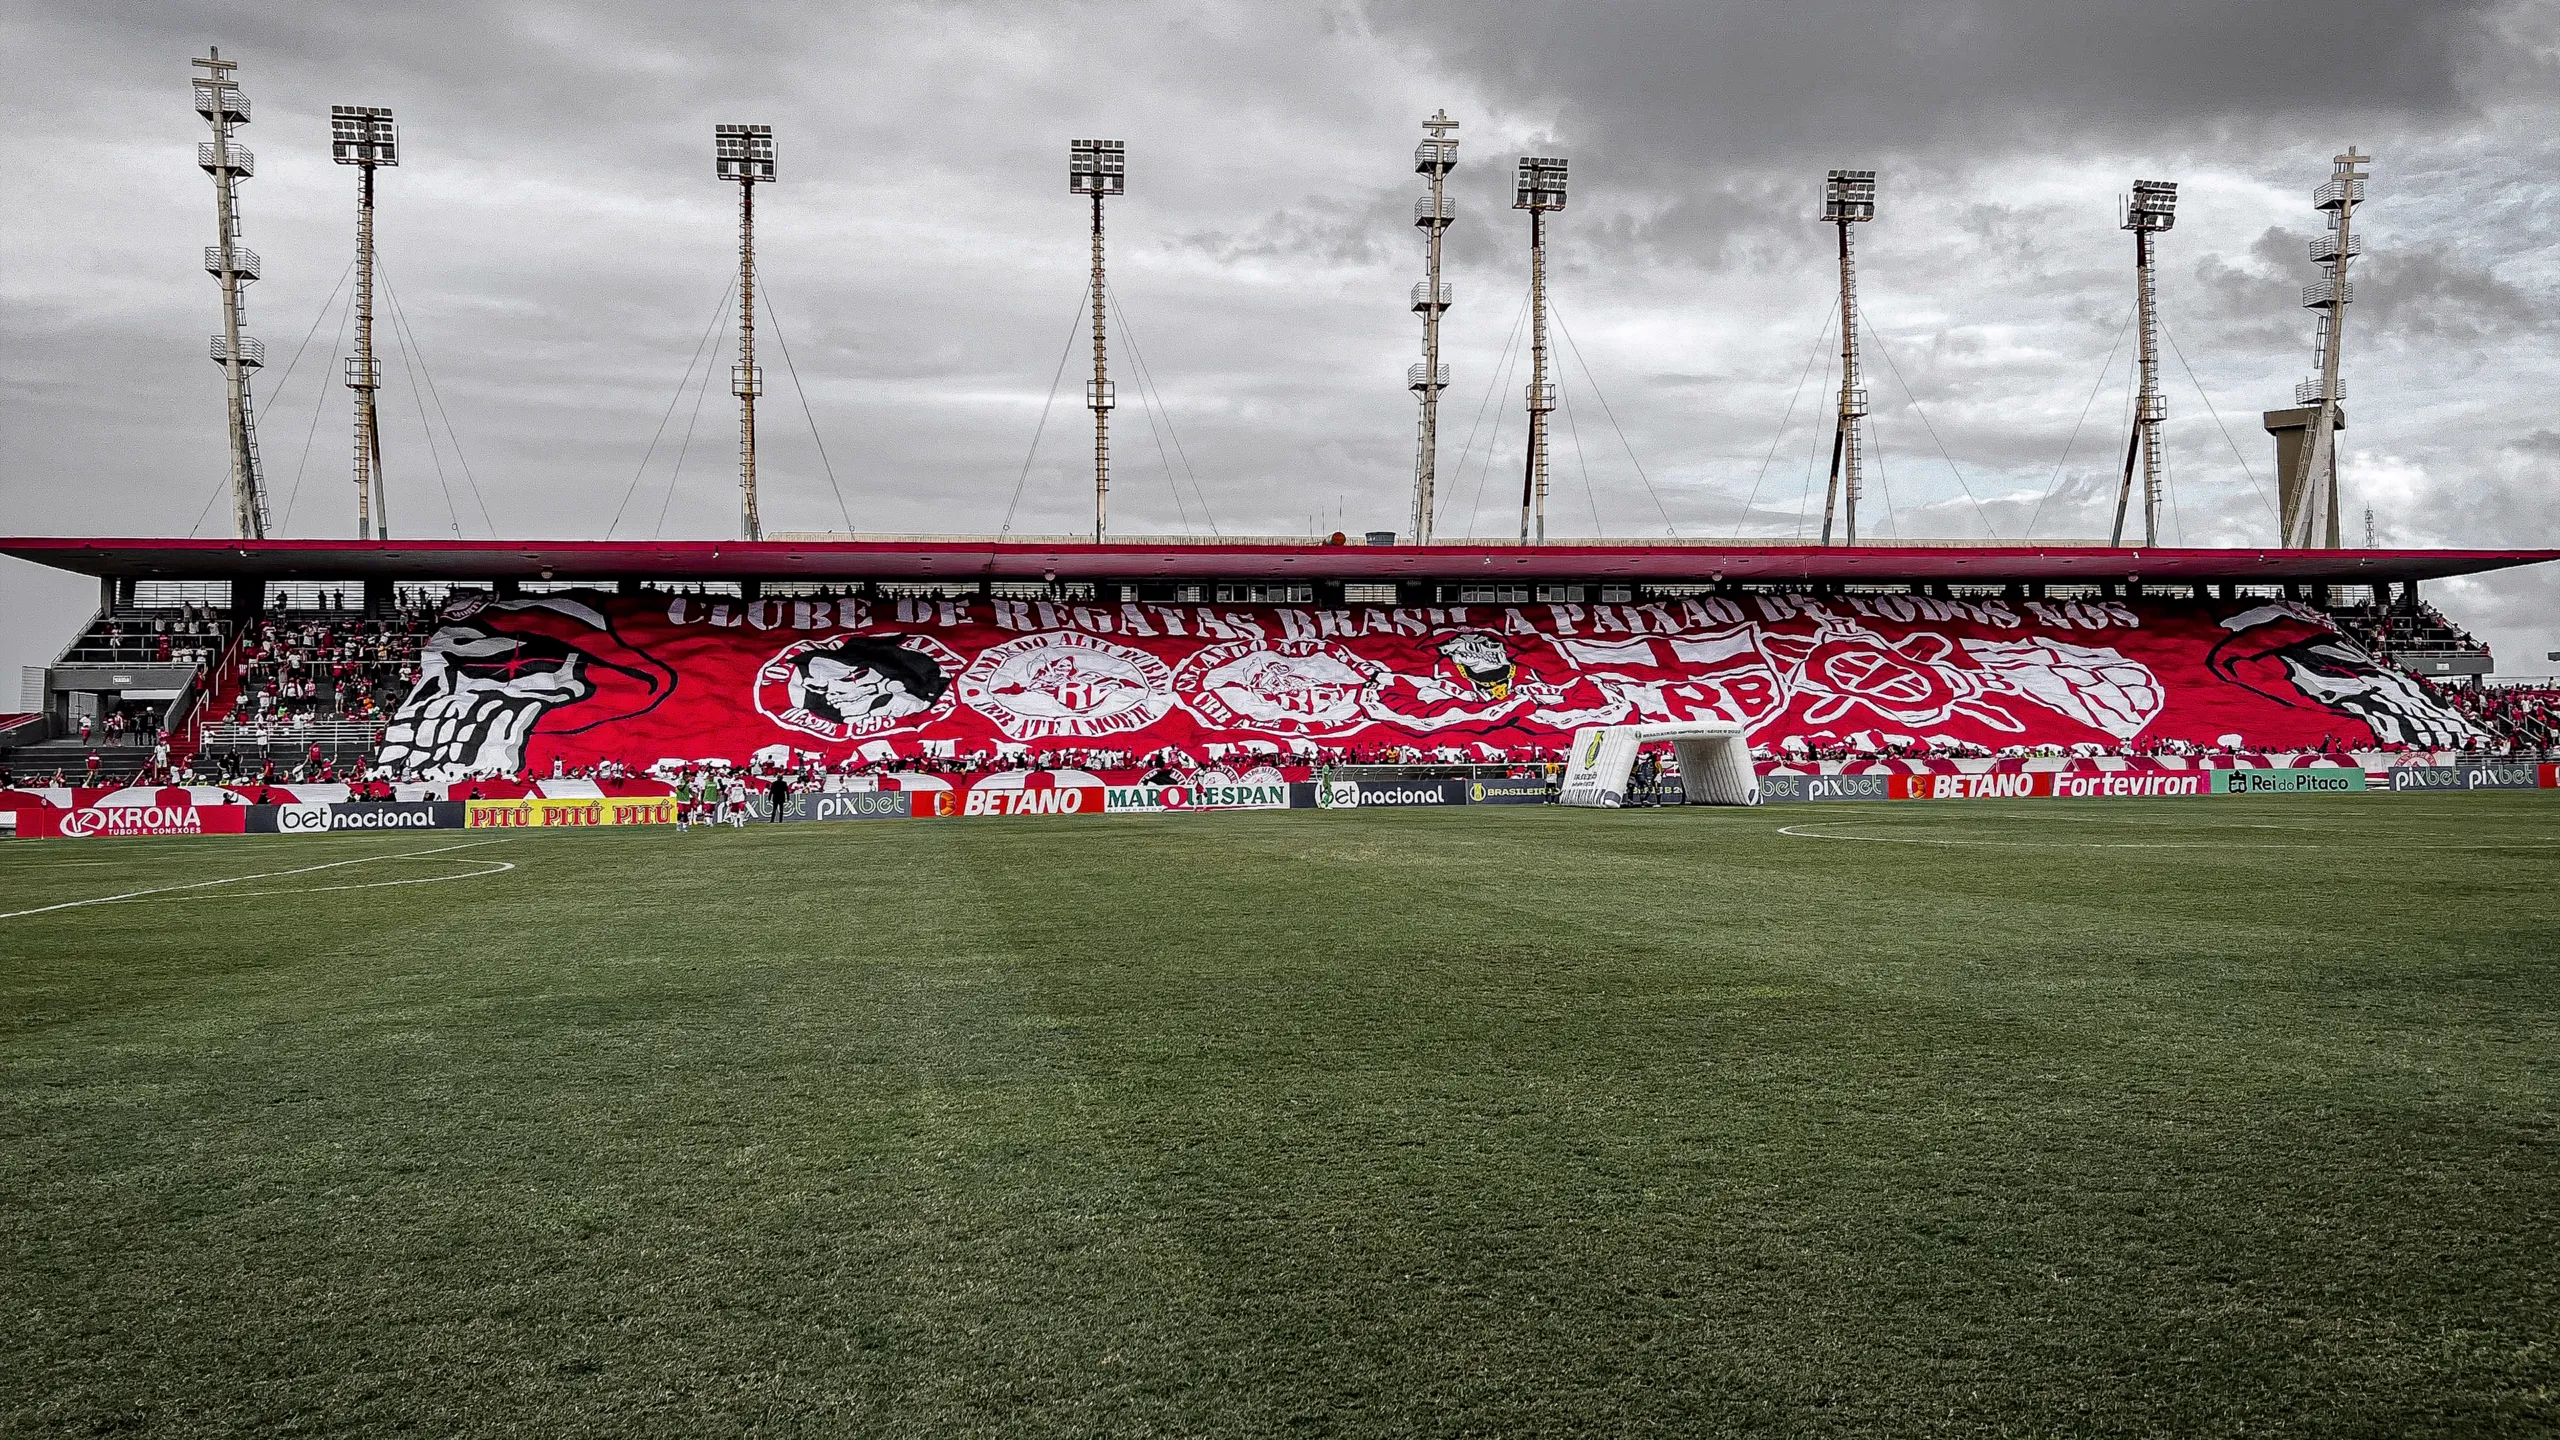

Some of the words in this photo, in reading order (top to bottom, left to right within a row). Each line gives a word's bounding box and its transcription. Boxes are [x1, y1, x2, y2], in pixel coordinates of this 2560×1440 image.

[667, 598, 873, 630] CLUBE
[896, 598, 974, 627] DE
[990, 599, 1266, 640] REGATAS
[1504, 608, 1540, 636] A
[1058, 632, 1111, 654] ALVI
[1760, 775, 1800, 797] bet
[1808, 776, 1882, 800] pixbet
[1933, 773, 2033, 798] BETANO
[2052, 771, 2198, 797] Forteviron
[2252, 775, 2276, 791] Rei
[2278, 778, 2294, 791] do
[2296, 774, 2348, 791] Pitaco
[2395, 767, 2462, 791] pixbet
[2468, 766, 2534, 789] pixbet
[817, 791, 904, 820] pixbet
[964, 788, 1083, 816] BETANO
[108, 807, 201, 829] KRONA
[108, 828, 138, 836] TUBOS
[143, 828, 149, 836] E
